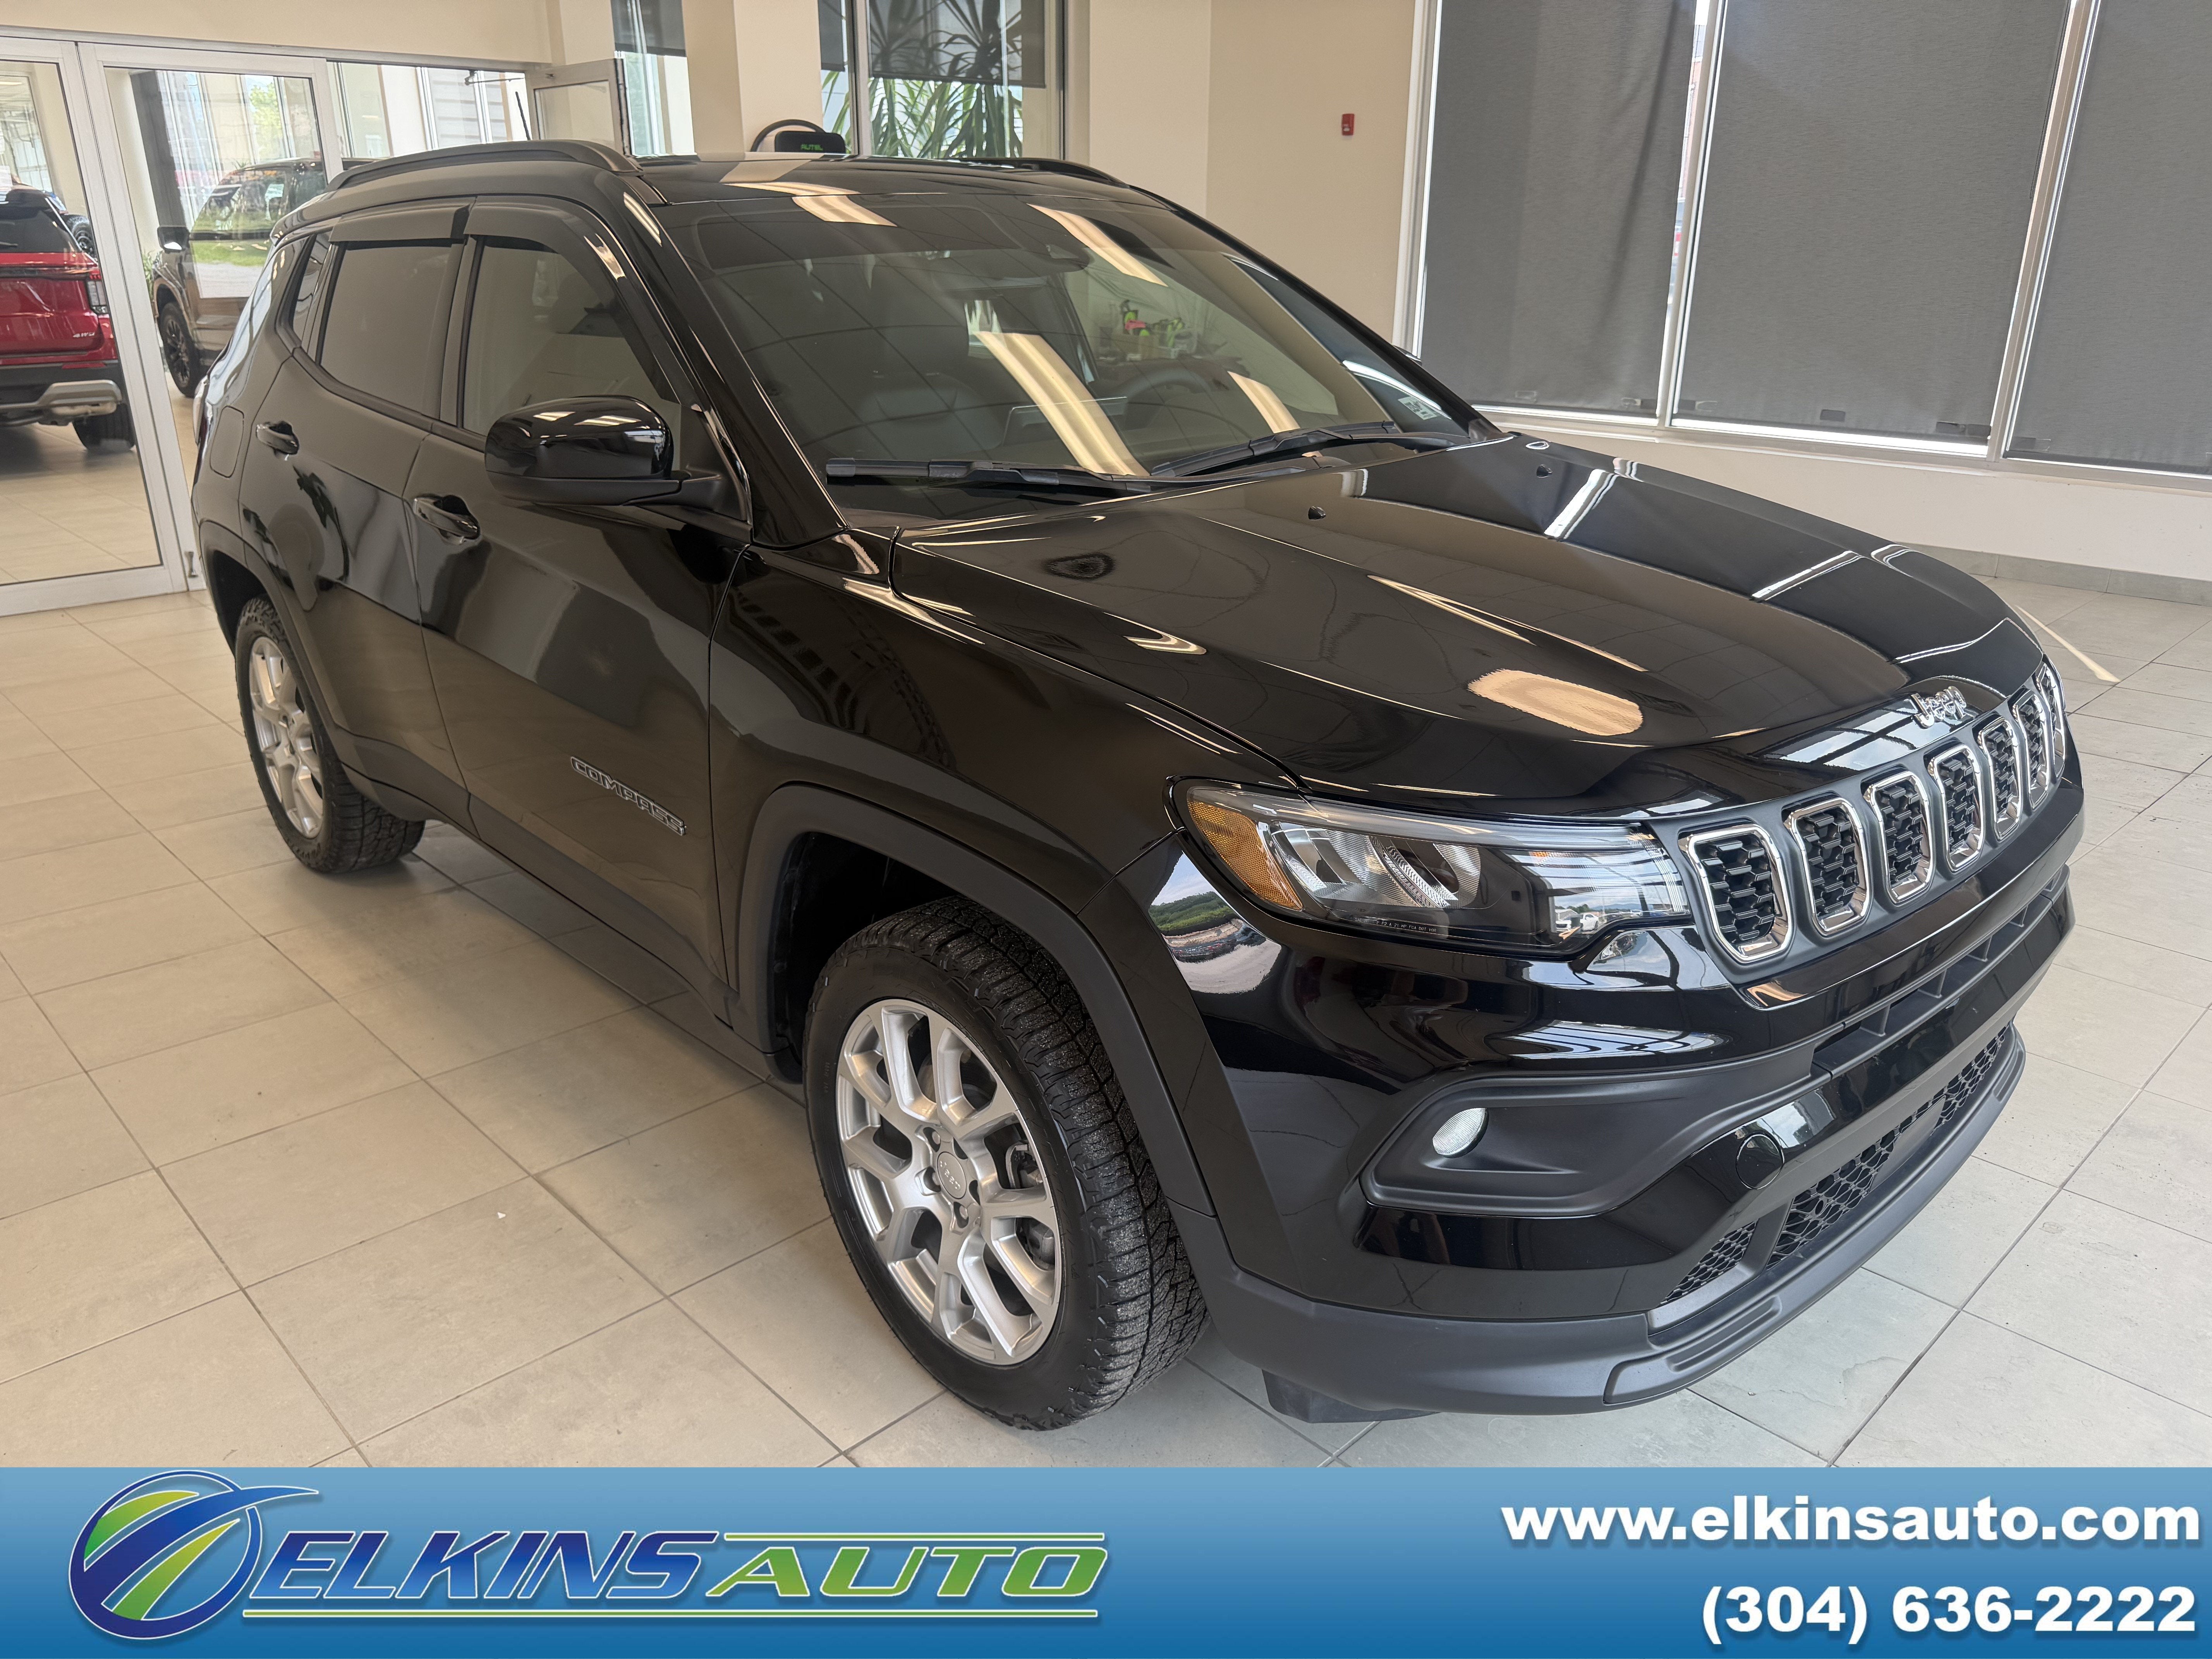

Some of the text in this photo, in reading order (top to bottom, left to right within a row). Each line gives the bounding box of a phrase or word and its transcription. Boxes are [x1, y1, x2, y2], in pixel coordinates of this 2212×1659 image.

[1911, 686, 1966, 729] Jeep
[570, 756, 685, 836] COMPASS
[940, 1160, 960, 1190] Jeep
